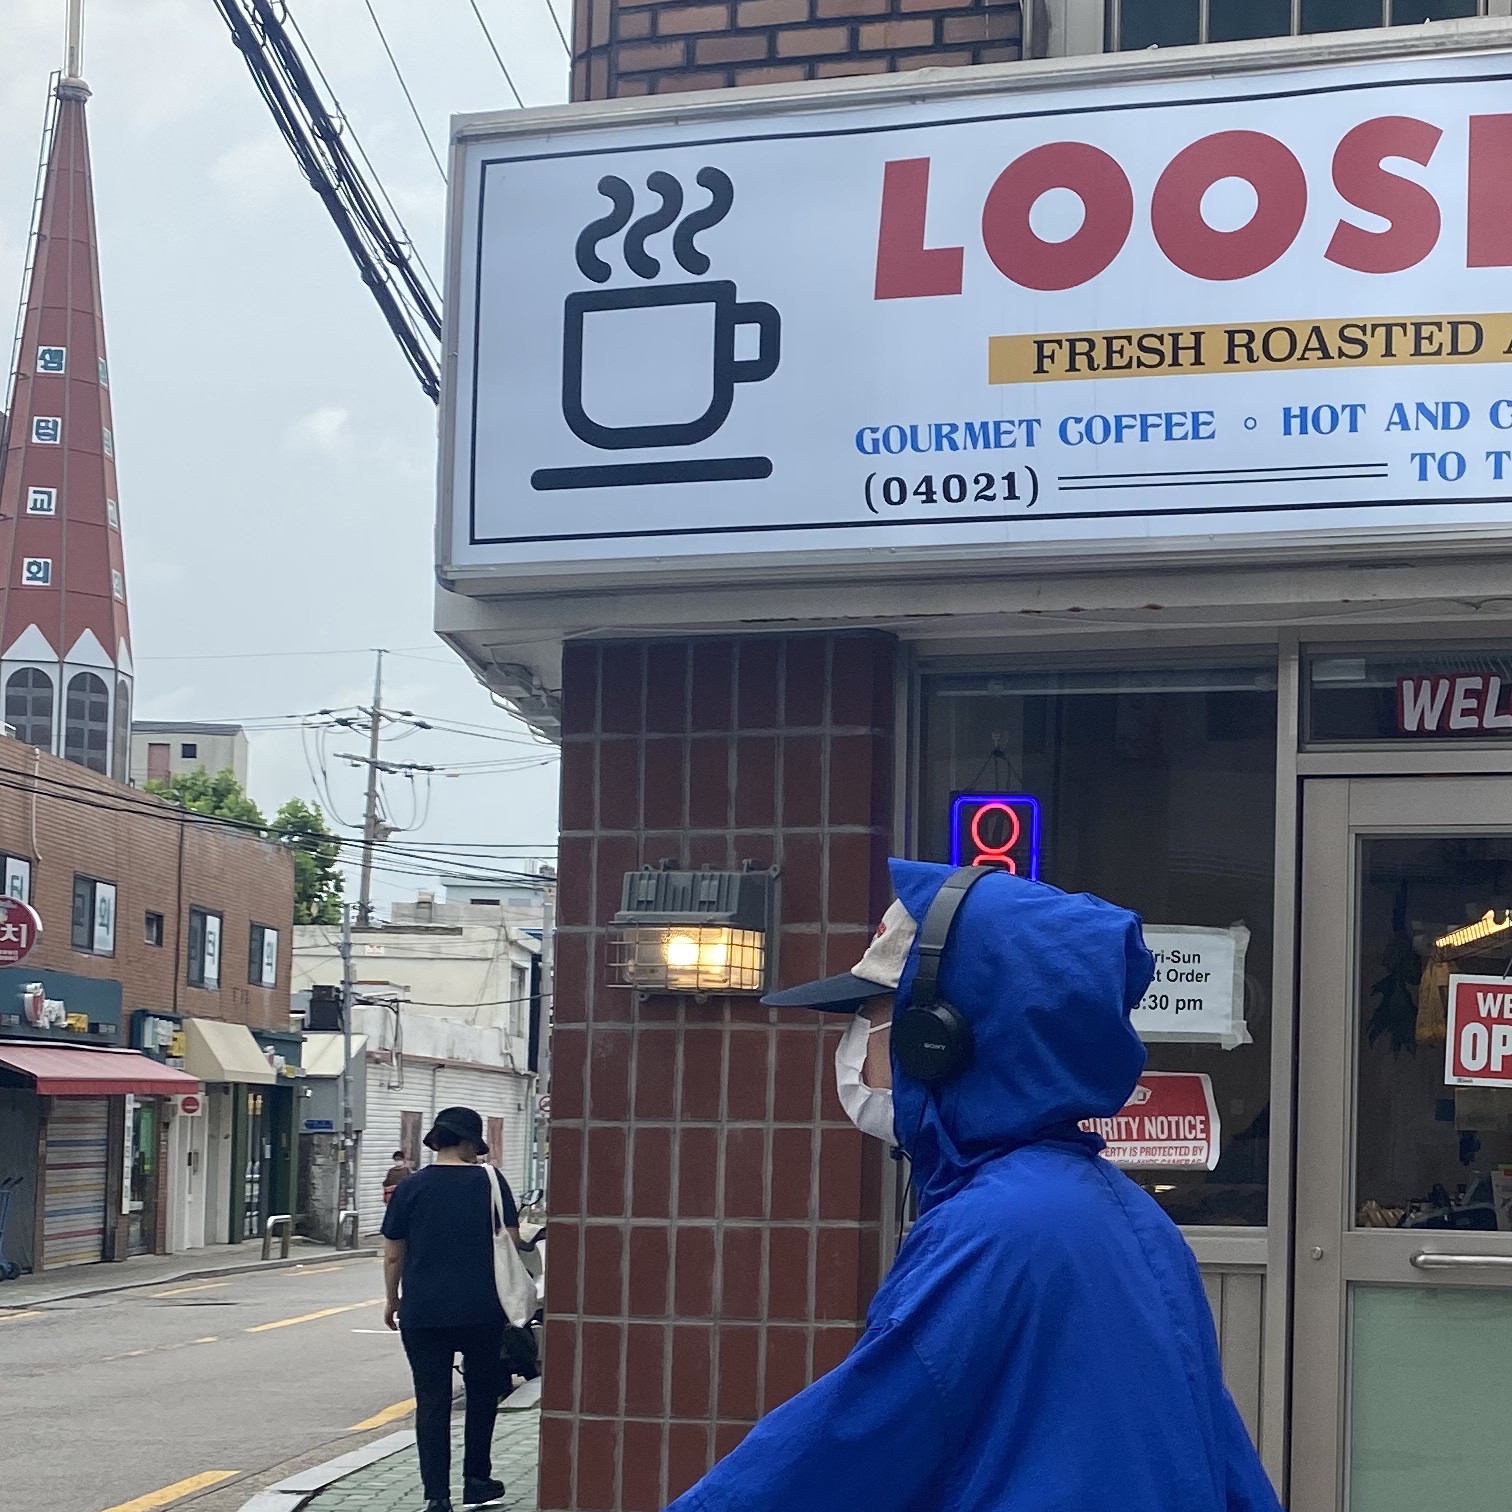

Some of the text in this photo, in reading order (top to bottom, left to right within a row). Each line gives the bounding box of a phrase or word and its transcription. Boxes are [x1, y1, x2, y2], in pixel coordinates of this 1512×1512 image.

[1032, 331, 1205, 374] FRESH
[1222, 320, 1484, 365] ROASTED
[1281, 402, 1368, 437] HOT
[1384, 400, 1472, 433] AND
[854, 409, 1217, 457] GOURMET COFFEE
[1409, 450, 1468, 483] TO
[865, 466, 1040, 509] (04021)
[1153, 950, 1201, 964] ri-Sun
[1166, 968, 1211, 983] Order
[1175, 998, 1203, 1015] pm
[924, 1043, 946, 1051] SONY
[1077, 1115, 1206, 1140] CURITY NOTICE
[1129, 1146, 1138, 1157] IS
[1140, 1146, 1190, 1157] PROTECTED
[1192, 1146, 1205, 1157] BY
